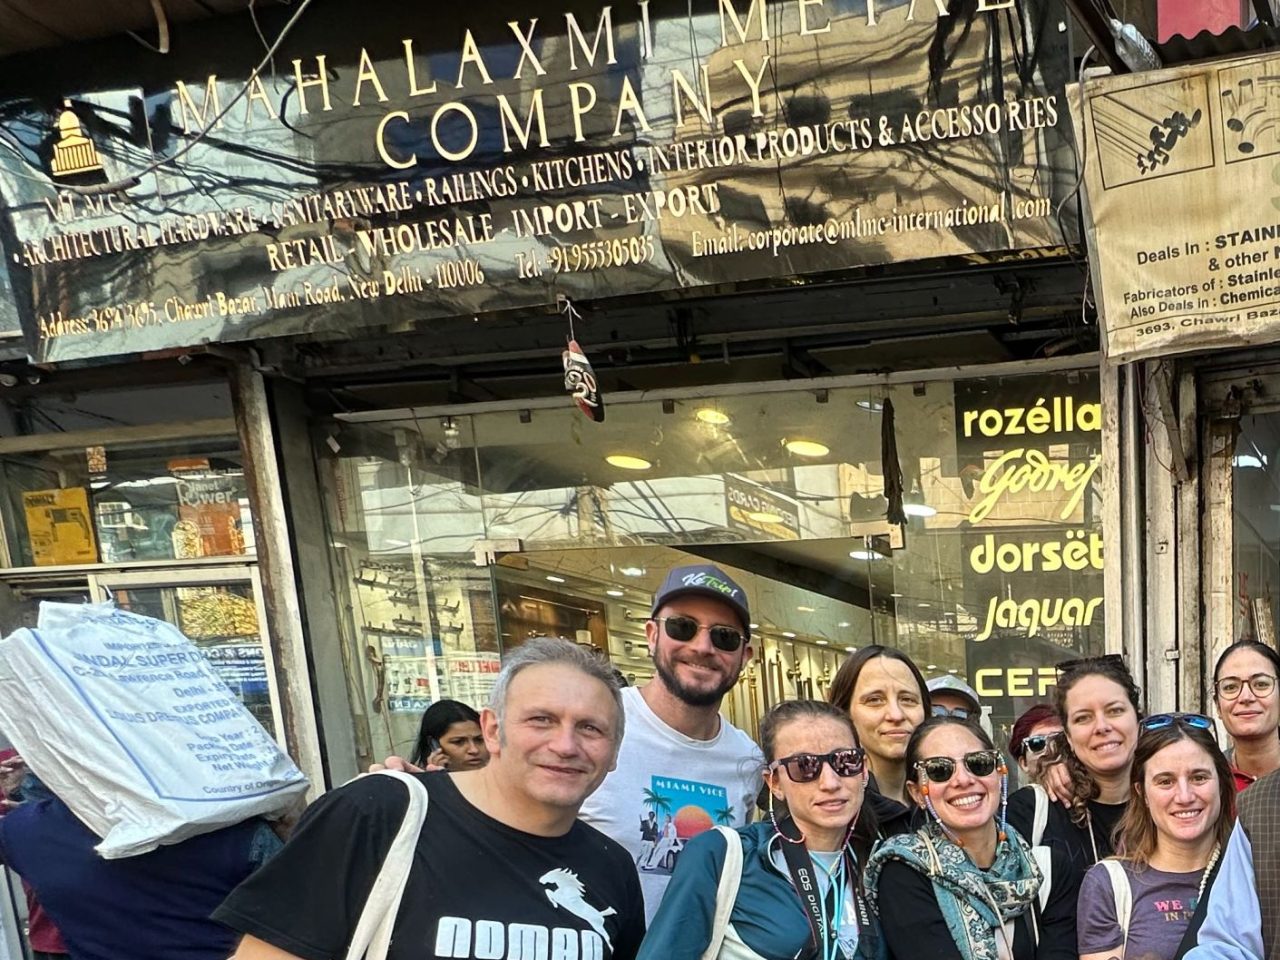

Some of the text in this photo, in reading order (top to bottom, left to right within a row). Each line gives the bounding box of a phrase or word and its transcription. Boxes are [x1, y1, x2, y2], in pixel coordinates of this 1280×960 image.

[176, 0, 653, 136] MAHALAXMI
[376, 55, 770, 169] COMPANY
[23, 224, 158, 266] ARCHITECTURAL
[159, 206, 259, 245] HARDWARE
[271, 181, 413, 229] SANITARYWARE
[424, 166, 517, 206] RAILINGS
[531, 149, 633, 191] KITCHENS
[649, 134, 751, 176] INTERIOR
[755, 118, 872, 161] PRODUCTS
[878, 115, 895, 147] &
[266, 183, 719, 272] RETAIL WHOLESALE IMPORT EXPORT
[691, 223, 743, 257] Email:
[515, 249, 543, 279] Tel:
[1137, 246, 1180, 265] Deals
[1185, 242, 1199, 255] In
[1208, 257, 1220, 272] &
[1224, 251, 1269, 269] other
[164, 294, 214, 323] Chawri
[347, 274, 379, 300] New
[383, 266, 423, 295] Delhi
[435, 258, 484, 289] 110006
[1123, 285, 1198, 305] Fabricators
[1202, 278, 1216, 291] of
[1130, 304, 1155, 320] Also
[1158, 299, 1194, 313] Deals
[1198, 297, 1209, 309] in
[1136, 322, 1175, 337] 3693,
[1180, 314, 1241, 327] Chawri
[963, 397, 1102, 437] rozélla
[969, 448, 1101, 524] Godrej
[970, 530, 1104, 574] dorsët
[135, 652, 188, 667] SUPER
[202, 783, 242, 795] Country
[656, 780, 724, 797] MIAMI VICE
[798, 868, 812, 891] EOS
[1154, 900, 1183, 912] WE
[1165, 912, 1179, 921] IN
